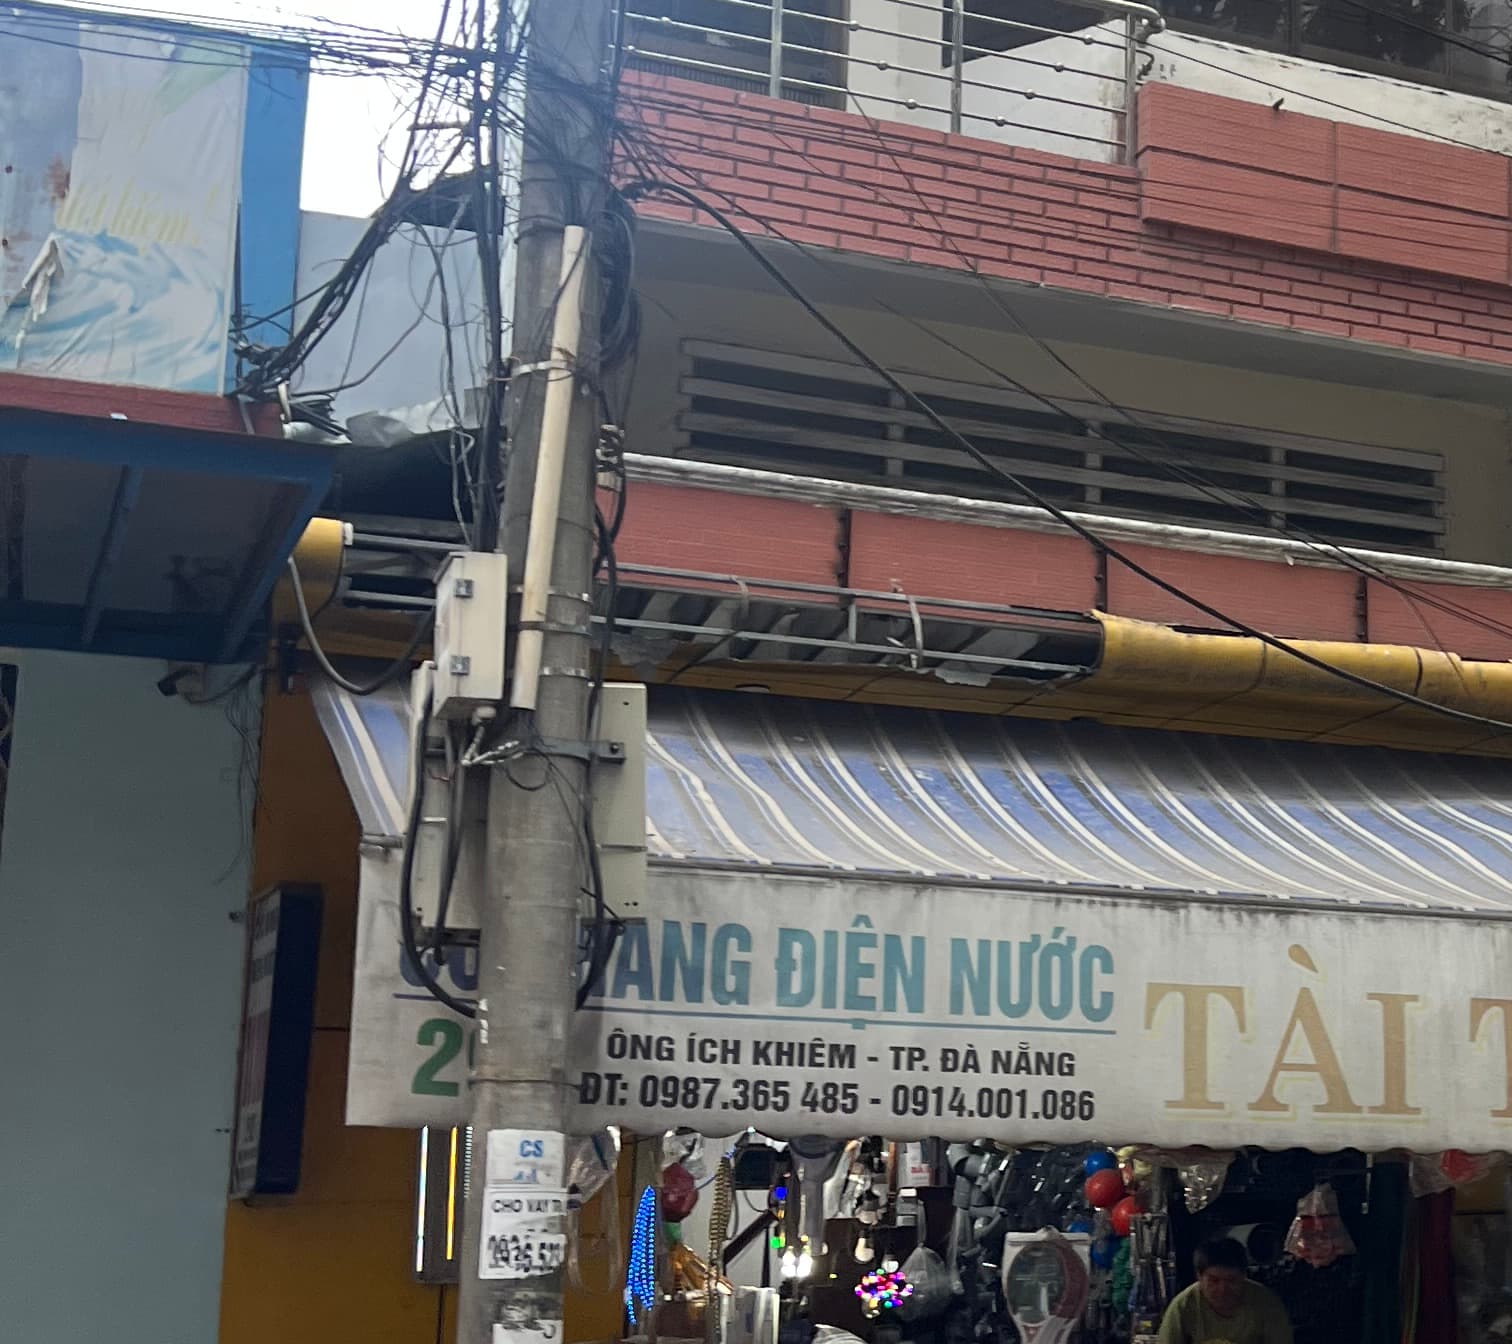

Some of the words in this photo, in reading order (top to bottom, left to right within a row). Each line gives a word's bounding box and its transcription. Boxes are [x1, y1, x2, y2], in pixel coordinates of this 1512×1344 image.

[774, 914, 927, 1030] ĐIỆN
[949, 926, 1115, 1023] NƯỚC
[607, 1028, 676, 1062] ÔNG
[687, 1032, 742, 1065] ÍCH
[752, 1037, 857, 1069] KHIÊM
[889, 1045, 930, 1072] TP.
[940, 1043, 981, 1074] ĐÀ
[1144, 943, 1423, 1116] TÀI
[579, 1071, 628, 1107] ĐT:
[892, 1084, 1096, 1121] 0914.001.086
[519, 1139, 544, 1157] CS
[491, 1199, 523, 1213] CHO
